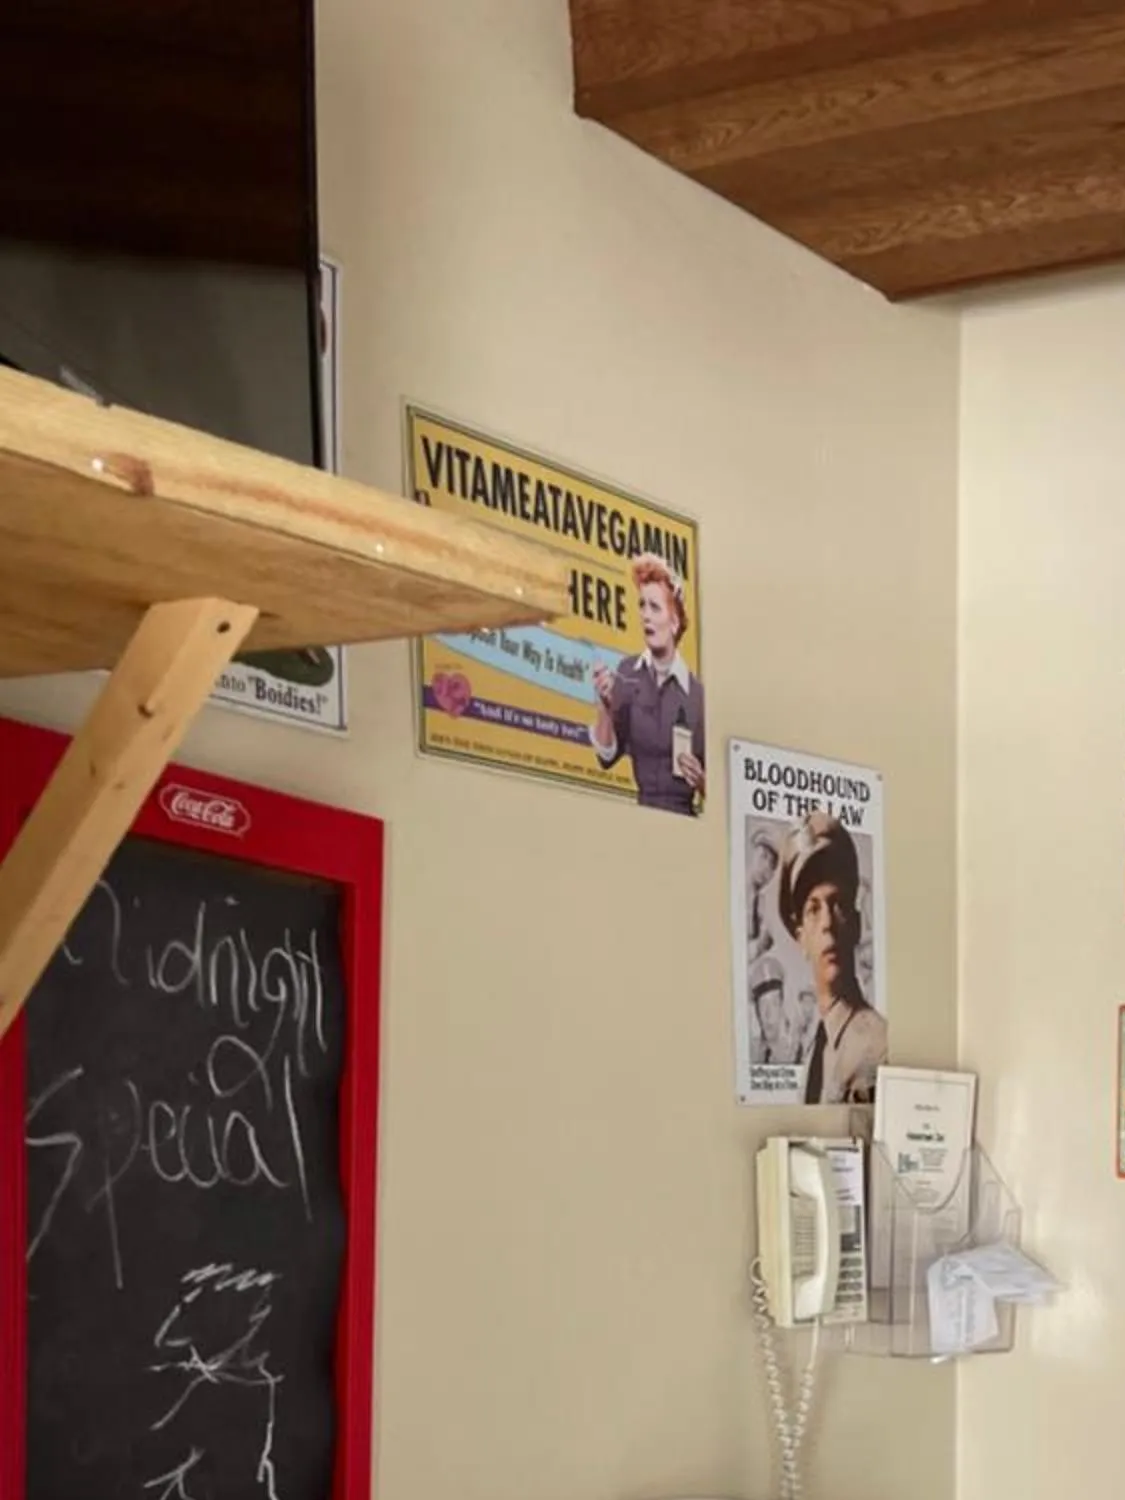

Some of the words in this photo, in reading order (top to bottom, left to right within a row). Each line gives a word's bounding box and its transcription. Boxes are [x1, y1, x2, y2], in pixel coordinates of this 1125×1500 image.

[420, 434, 689, 581] VITAMEATAVEGAMIN
[214, 672, 247, 694] nto
[744, 757, 871, 802] BLOODHOUND
[752, 788, 779, 812] OF
[783, 793, 821, 816] THE
[827, 801, 864, 826] LAW
